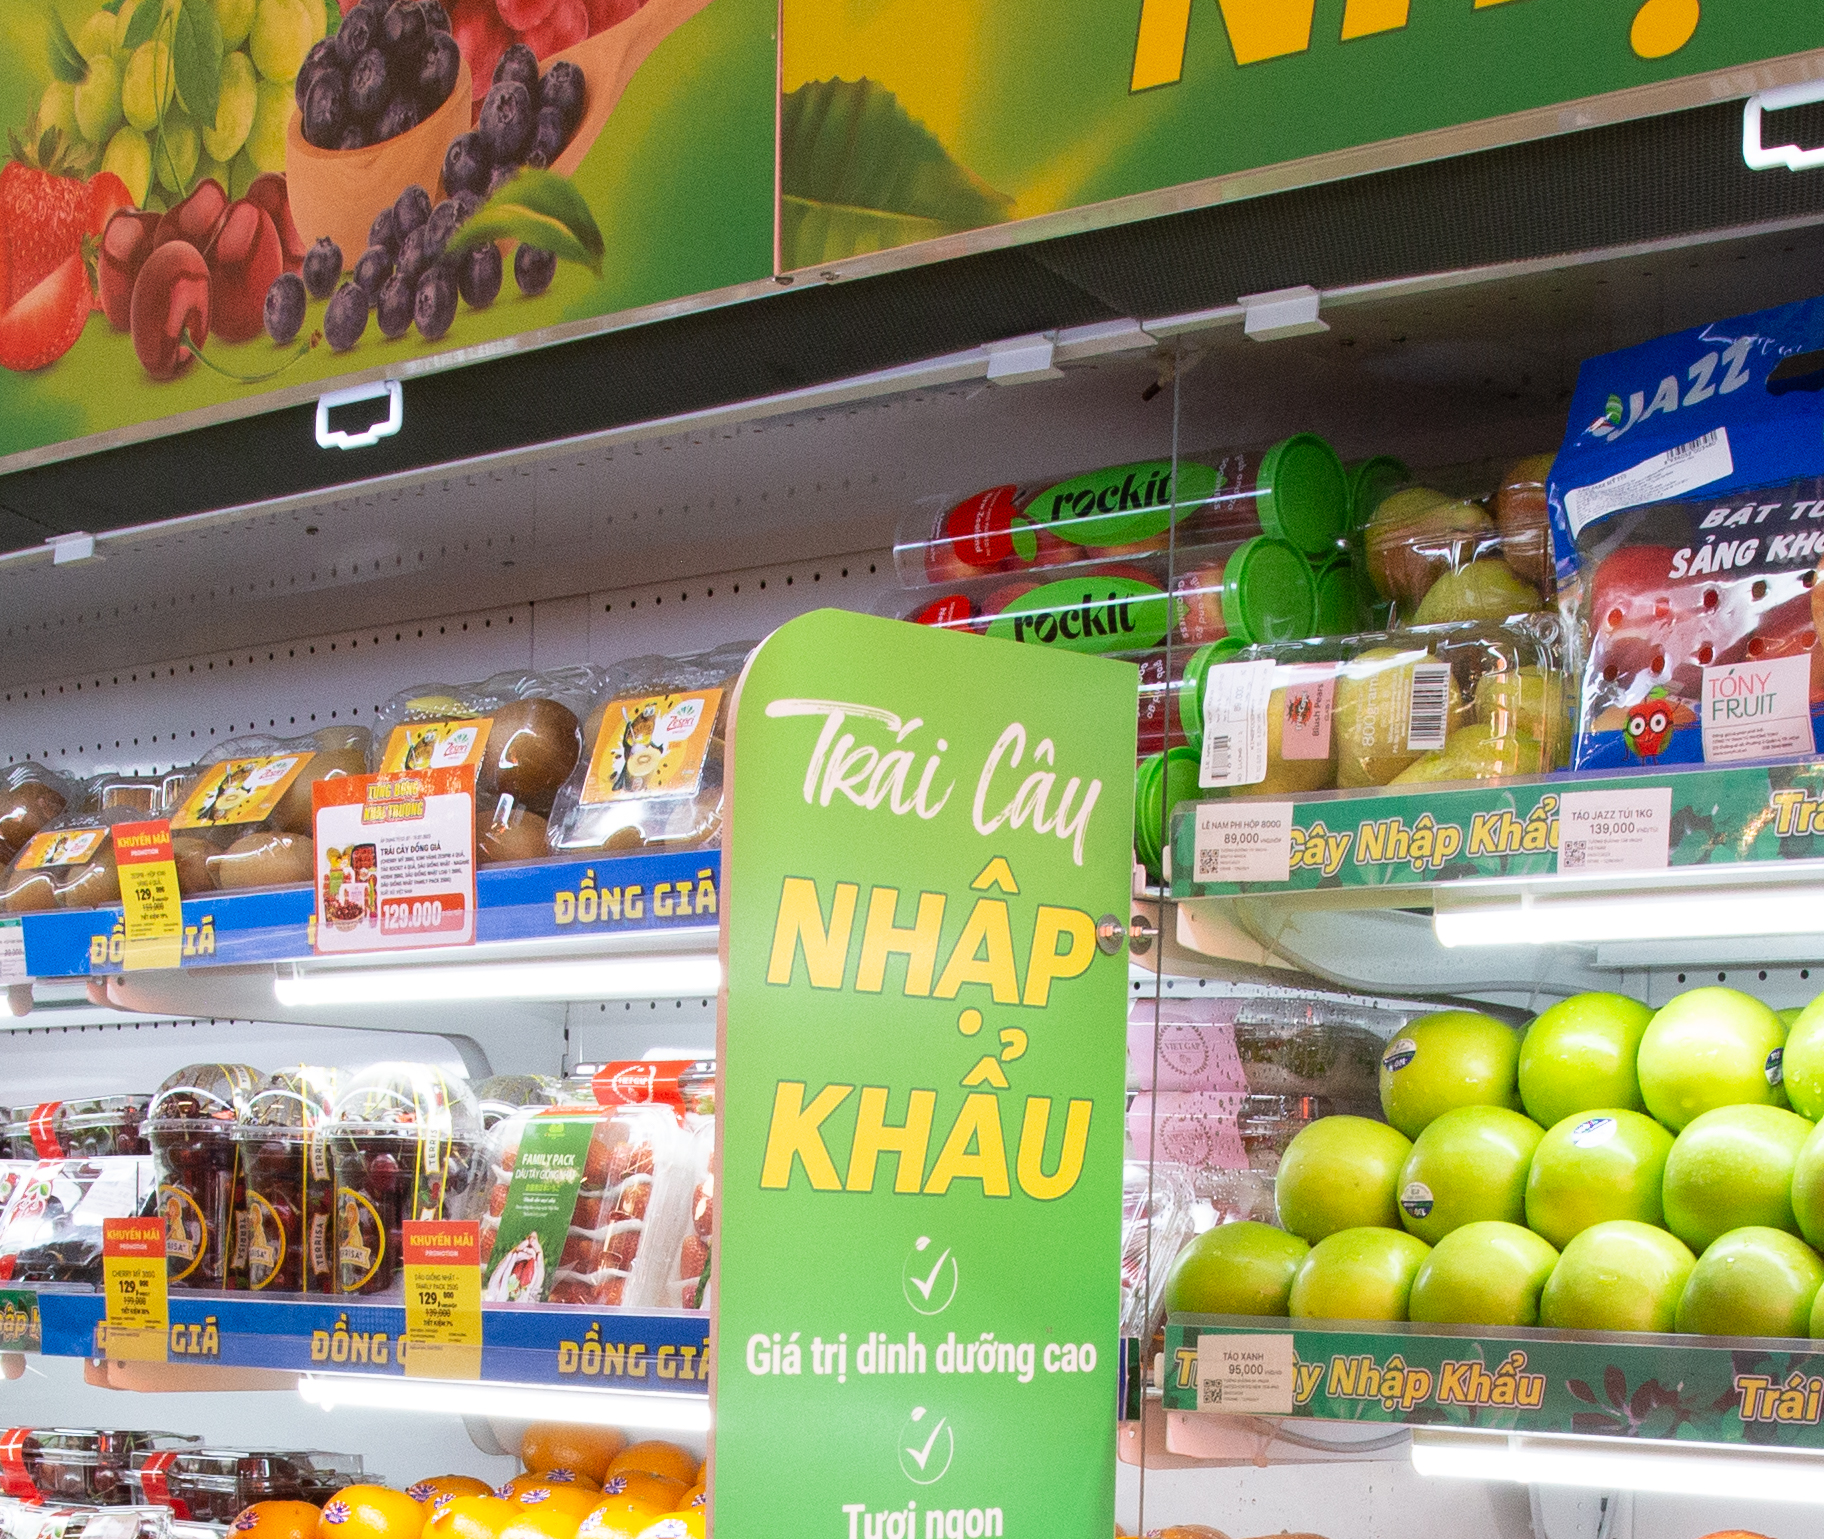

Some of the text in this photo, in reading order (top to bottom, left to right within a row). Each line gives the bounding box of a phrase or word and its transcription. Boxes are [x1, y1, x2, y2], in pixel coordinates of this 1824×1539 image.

[1607, 335, 1761, 442] JAZZ
[1050, 468, 1175, 522] rockit
[1700, 503, 1780, 532] BẬT
[1668, 535, 1755, 580] SẢNG
[1014, 591, 1136, 643] rockit
[765, 698, 957, 820] Trái
[972, 721, 1104, 867] Cây
[380, 840, 441, 856] TRÁI CÂY ĐỒNG GIÁ
[1589, 821, 1635, 835] 139,000
[382, 900, 443, 929] 129.000
[553, 867, 717, 929] ĐỒNG GIÁ
[765, 855, 1096, 1037] NHẬP
[759, 1027, 1094, 1200] KHẨU
[521, 1153, 576, 1166] FAMILY PACK
[310, 1214, 327, 1274] TERRISA
[409, 1232, 474, 1248] KHUYẾN MÃI
[171, 1316, 221, 1357] GIÁ
[311, 1312, 390, 1365] ĐỒNG
[558, 1321, 648, 1379] ĐỒNG
[746, 1330, 1099, 1386] Giá trị dinh dưỡng cao
